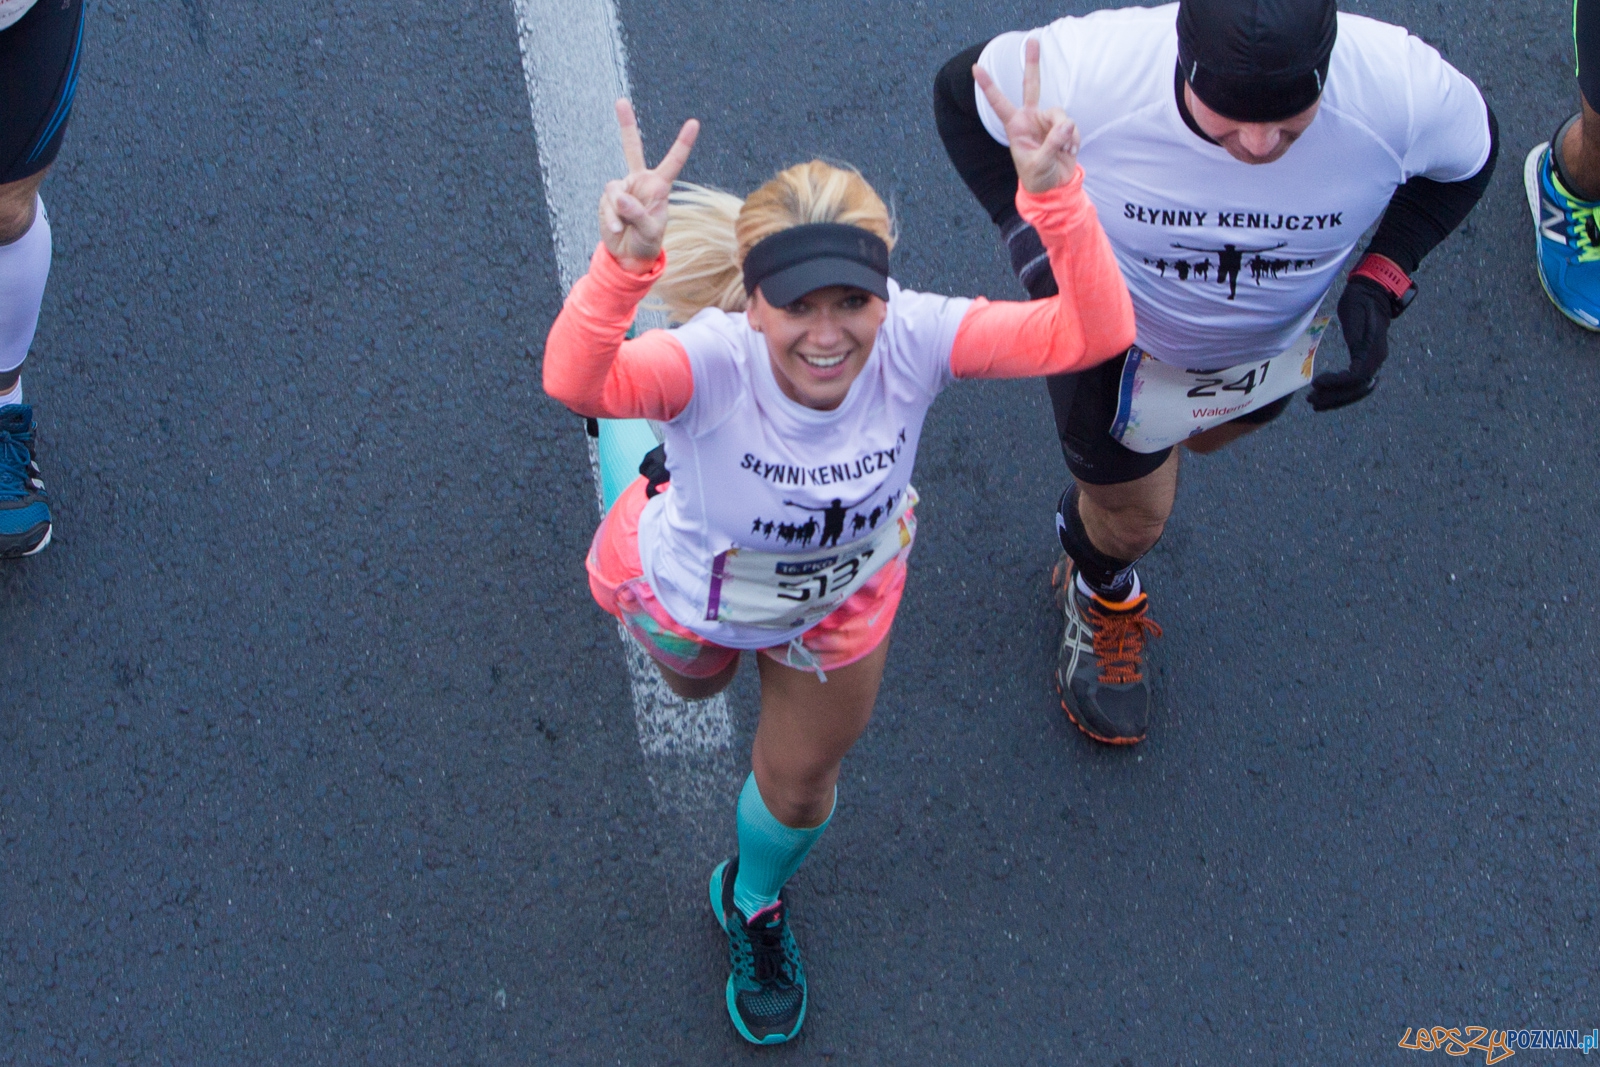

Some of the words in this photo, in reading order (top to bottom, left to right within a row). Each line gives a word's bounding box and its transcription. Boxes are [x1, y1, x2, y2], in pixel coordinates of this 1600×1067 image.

[1123, 202, 1208, 227] SŁYNNY
[1217, 211, 1344, 231] KENIJCZYK
[1185, 360, 1271, 398] 241
[740, 453, 806, 486] SŁYNNI
